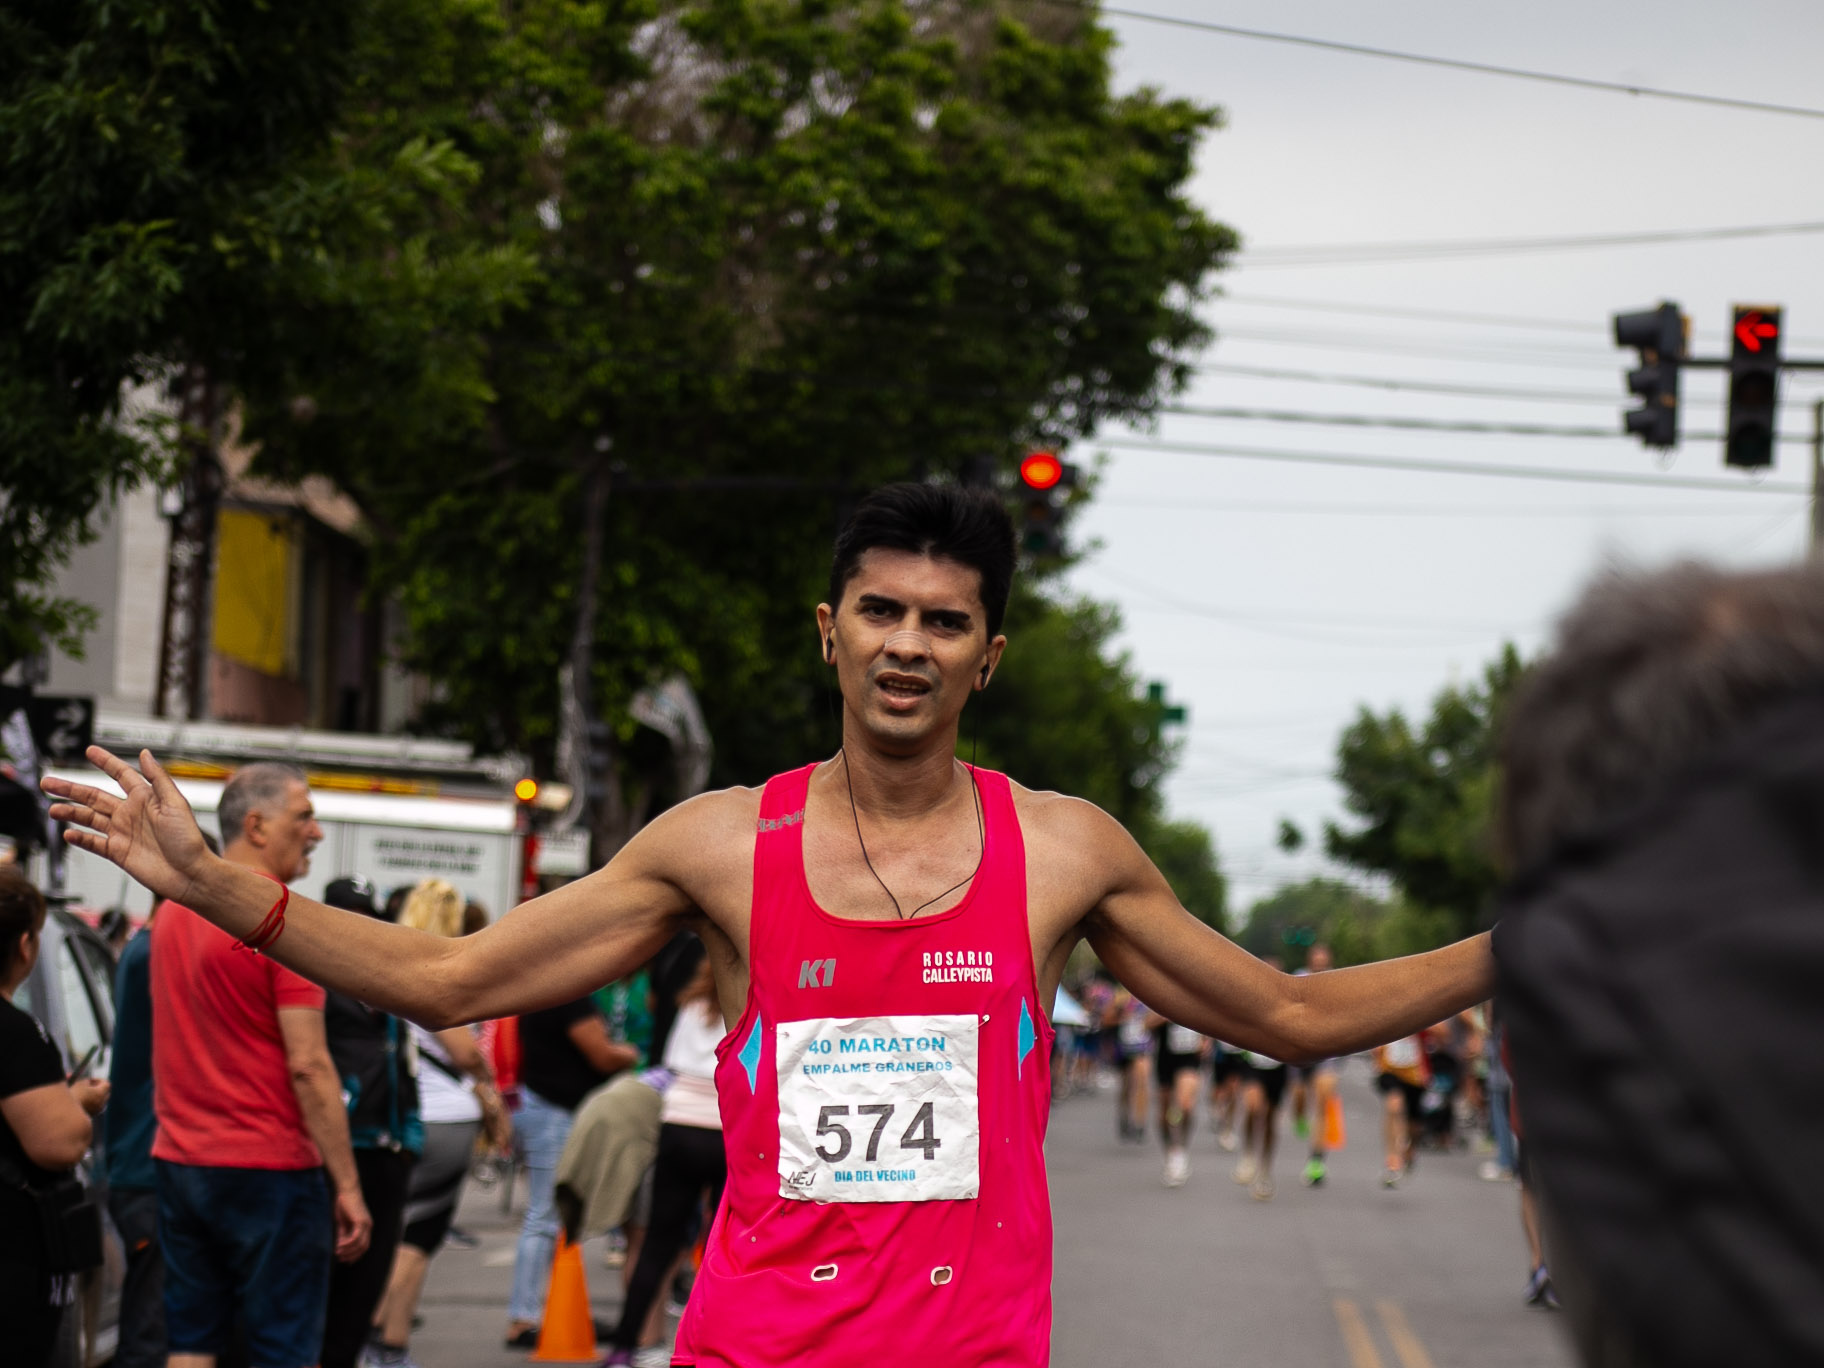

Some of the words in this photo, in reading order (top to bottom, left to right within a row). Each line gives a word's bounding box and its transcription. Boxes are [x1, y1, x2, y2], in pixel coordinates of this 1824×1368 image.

[923, 951, 993, 967] ROSARIO
[798, 958, 837, 989] K1
[923, 967, 993, 984] CALLEYPISTA
[808, 1039, 832, 1055] 40
[839, 1037, 946, 1054] MARATON
[803, 1062, 871, 1075] EMPALME
[875, 1061, 953, 1073] GRANEROS
[815, 1101, 941, 1163] 574
[834, 1170, 853, 1183] DIA
[855, 1170, 874, 1182] DEL
[876, 1169, 916, 1182] VECINO
